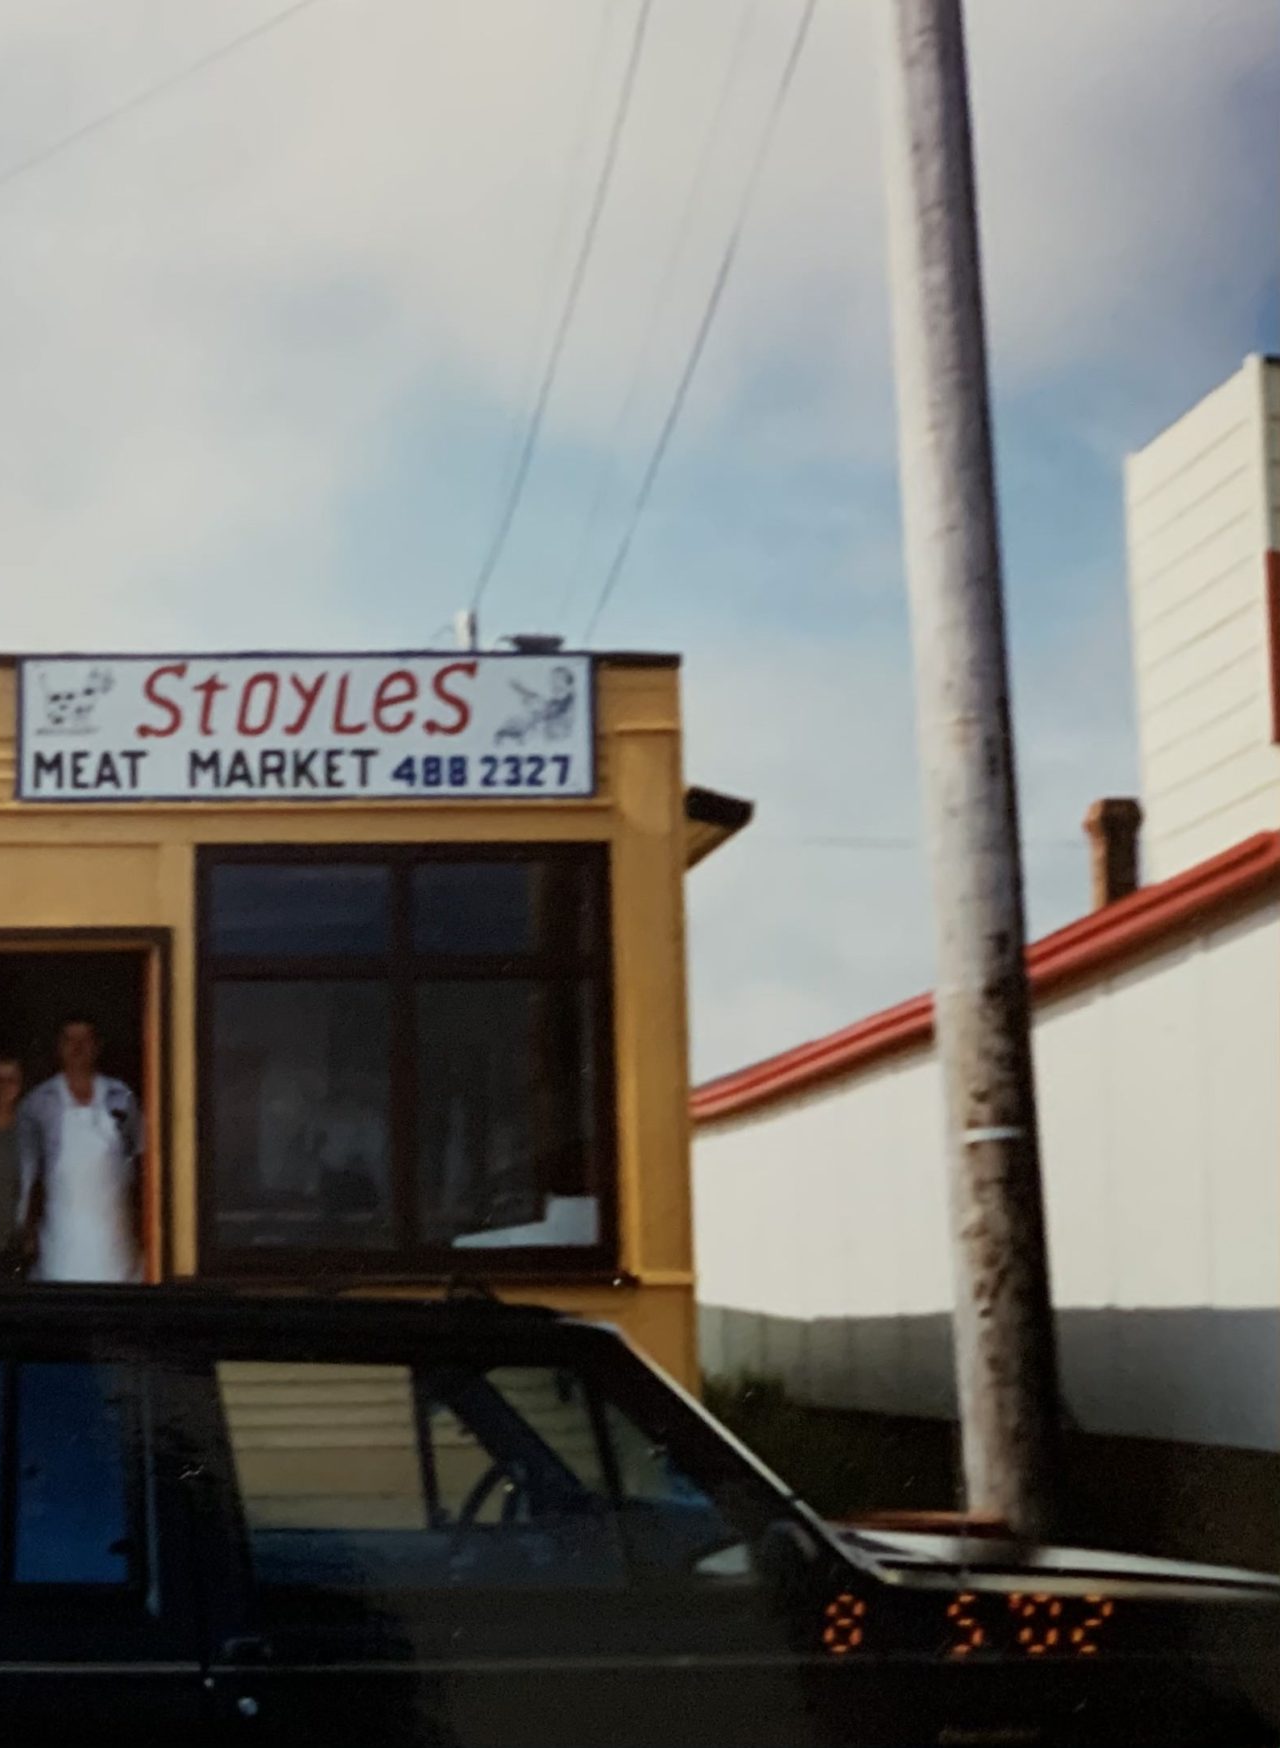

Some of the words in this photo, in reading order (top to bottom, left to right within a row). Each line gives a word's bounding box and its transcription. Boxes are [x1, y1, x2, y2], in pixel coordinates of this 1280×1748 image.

[32, 750, 147, 790] MEAT
[188, 749, 380, 789] MARKET
[391, 755, 468, 788] 488
[479, 755, 571, 788] 2327
